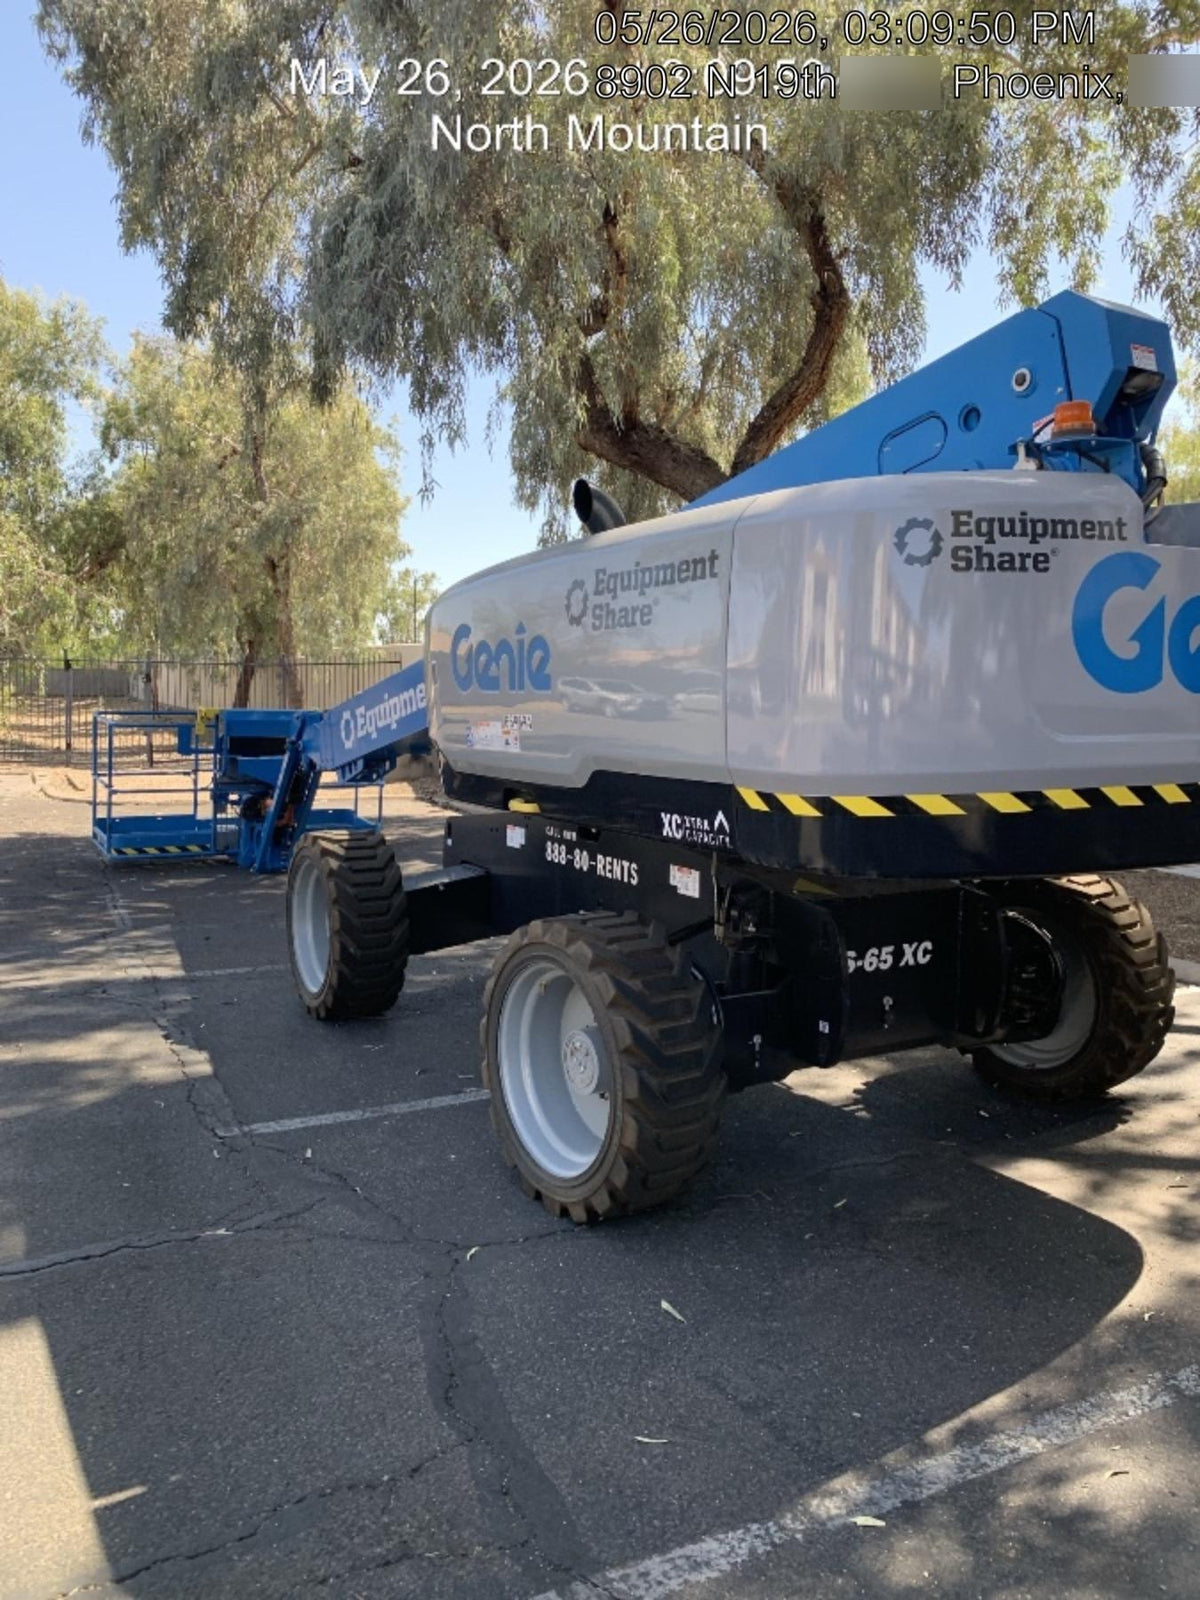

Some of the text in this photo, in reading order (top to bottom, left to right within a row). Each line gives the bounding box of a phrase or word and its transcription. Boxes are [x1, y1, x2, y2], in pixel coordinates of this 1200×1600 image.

[950, 510, 1128, 544] Equipment
[593, 549, 719, 600] Equipment
[950, 545, 1050, 573] Share
[591, 602, 653, 631] Share
[451, 621, 551, 692] Genie
[355, 682, 427, 739] Equipme
[661, 811, 684, 839] XC
[545, 841, 638, 886] 888-80-RENTS
[899, 940, 933, 967] XC
